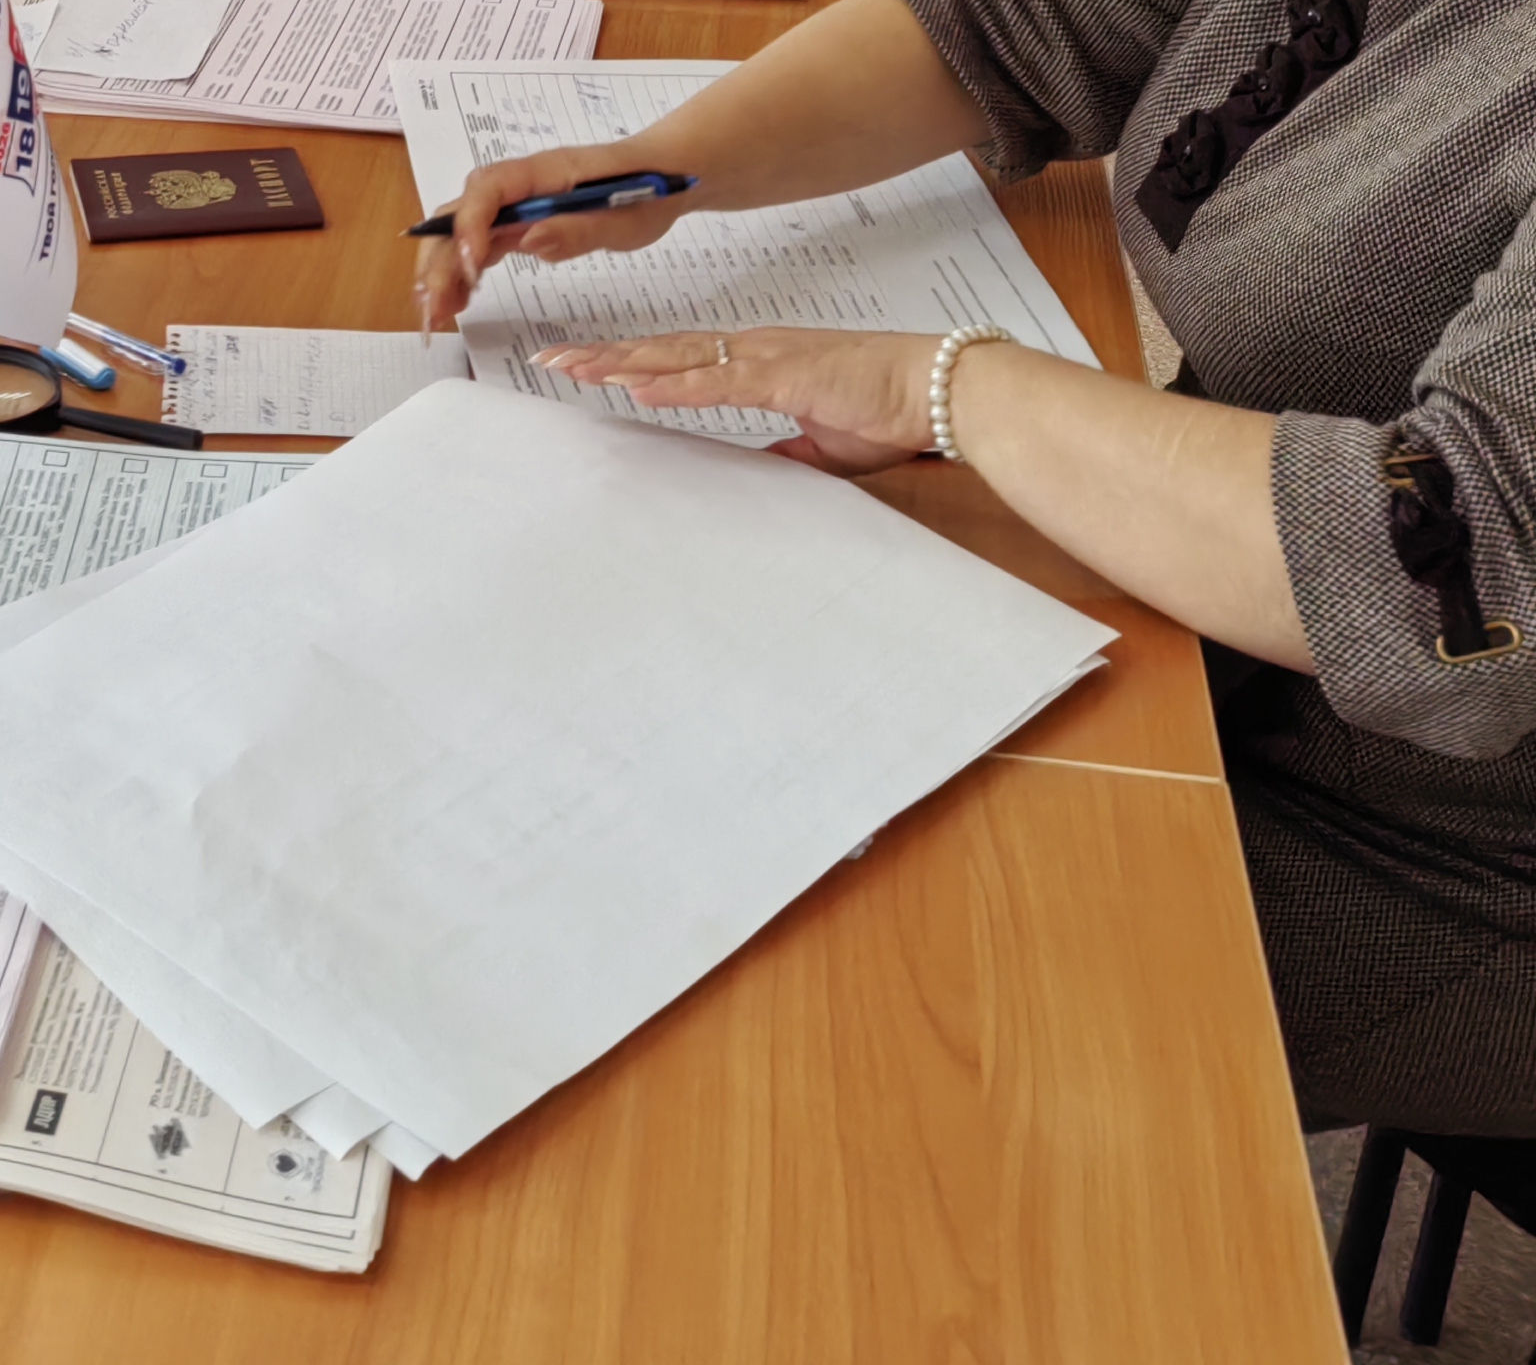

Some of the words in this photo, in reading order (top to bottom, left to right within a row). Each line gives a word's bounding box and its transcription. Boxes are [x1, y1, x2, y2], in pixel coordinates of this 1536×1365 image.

[15, 68, 33, 117] 19
[15, 123, 37, 173] 18
[250, 157, 296, 209] ПАСПОРТ
[39, 211, 56, 262] ТВОЙ
[34, 1094, 59, 1130] ЛДПР
